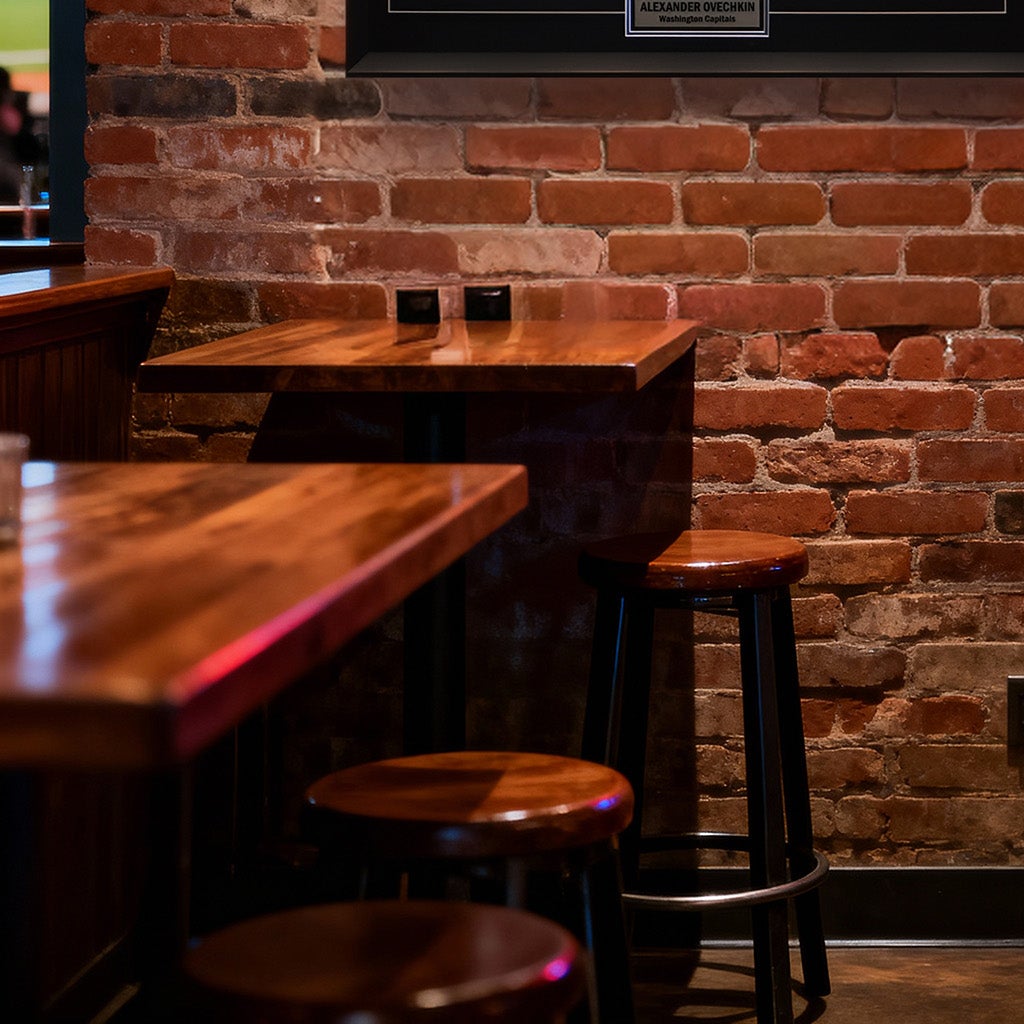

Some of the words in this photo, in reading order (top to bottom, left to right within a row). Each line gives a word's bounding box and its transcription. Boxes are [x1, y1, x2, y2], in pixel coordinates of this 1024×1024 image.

[640, 1, 701, 12] ALEXANDER
[703, 1, 755, 12] OVECHKIN
[659, 15, 703, 24] Washington
[704, 15, 736, 24] Capitals
